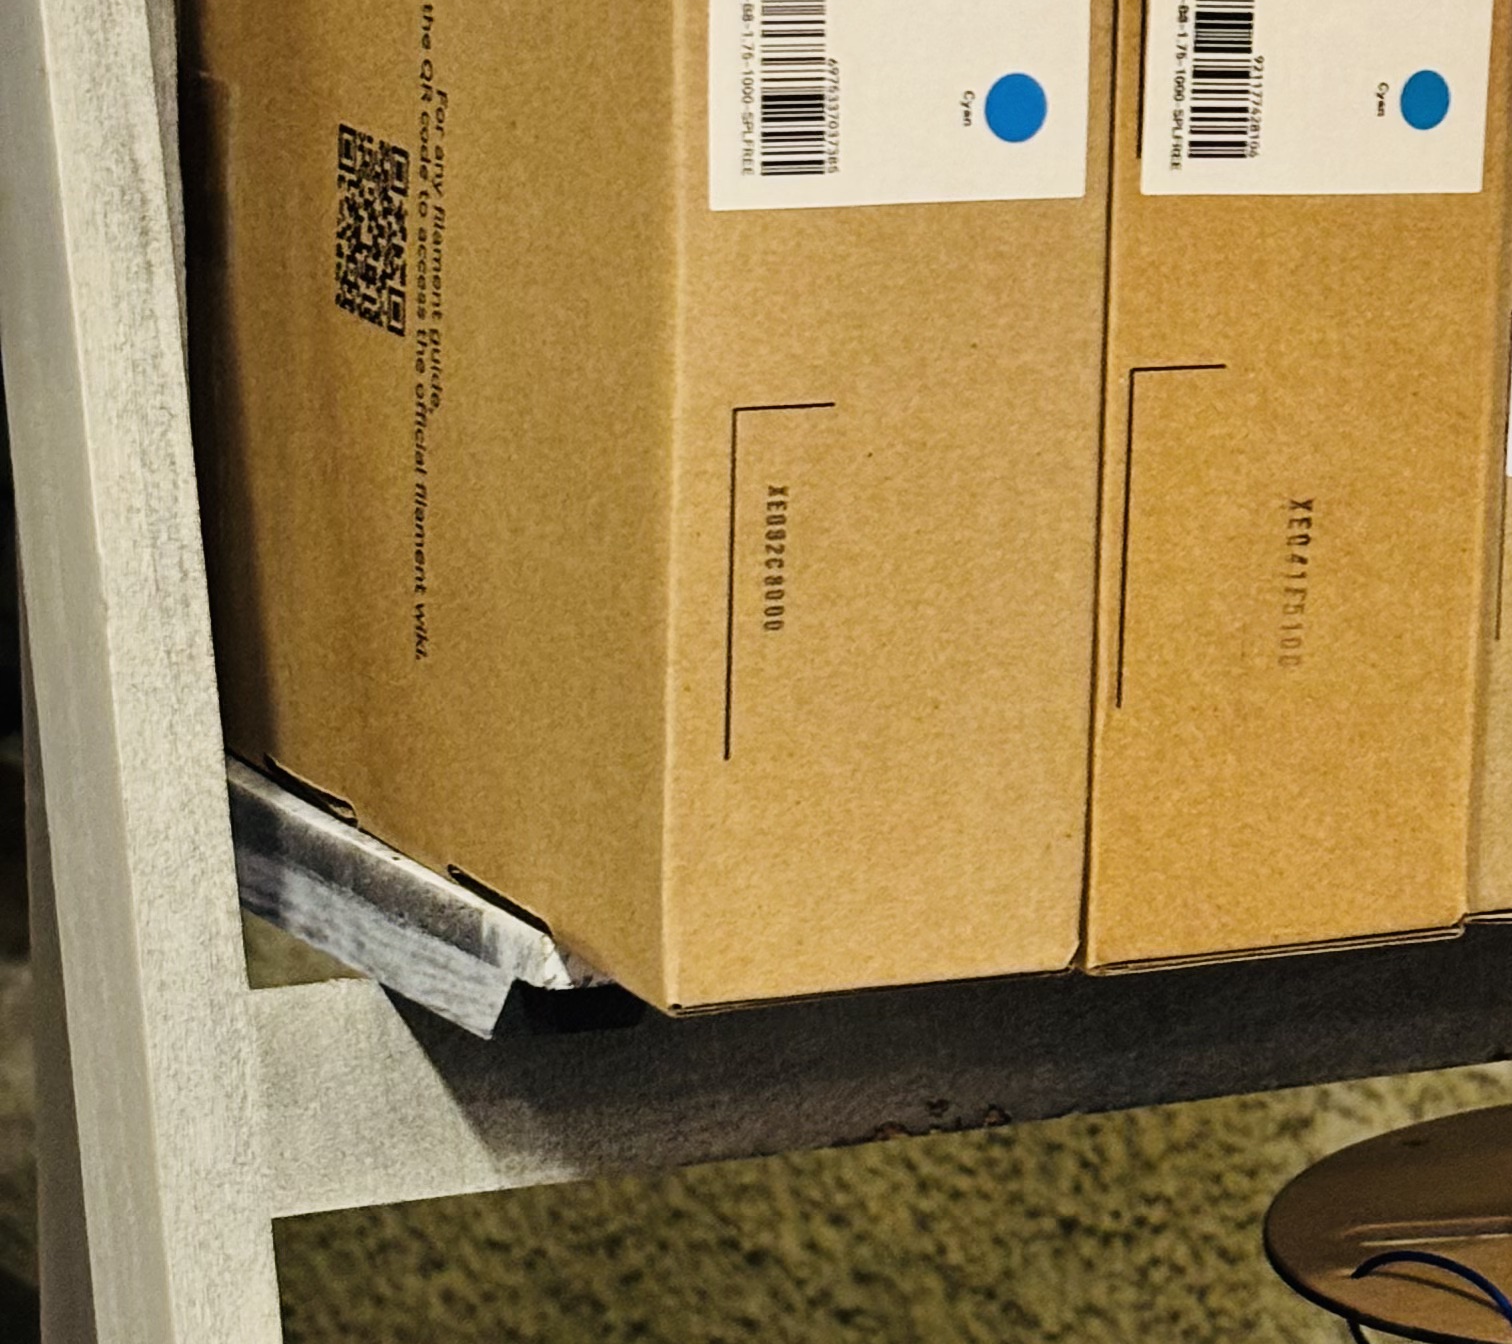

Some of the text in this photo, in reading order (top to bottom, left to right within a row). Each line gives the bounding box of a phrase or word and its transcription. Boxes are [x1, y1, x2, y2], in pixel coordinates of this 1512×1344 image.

[422, 5, 434, 49] the
[420, 59, 432, 102] QR
[1375, 82, 1389, 117] Cyan
[959, 90, 974, 127] Cyan
[419, 112, 432, 181] code
[419, 191, 429, 217] to
[417, 227, 426, 319] access
[426, 90, 447, 415] For any filament guide,
[416, 329, 431, 373] the
[415, 383, 430, 474] official
[415, 484, 427, 593] filament
[415, 604, 428, 659] wiki.
